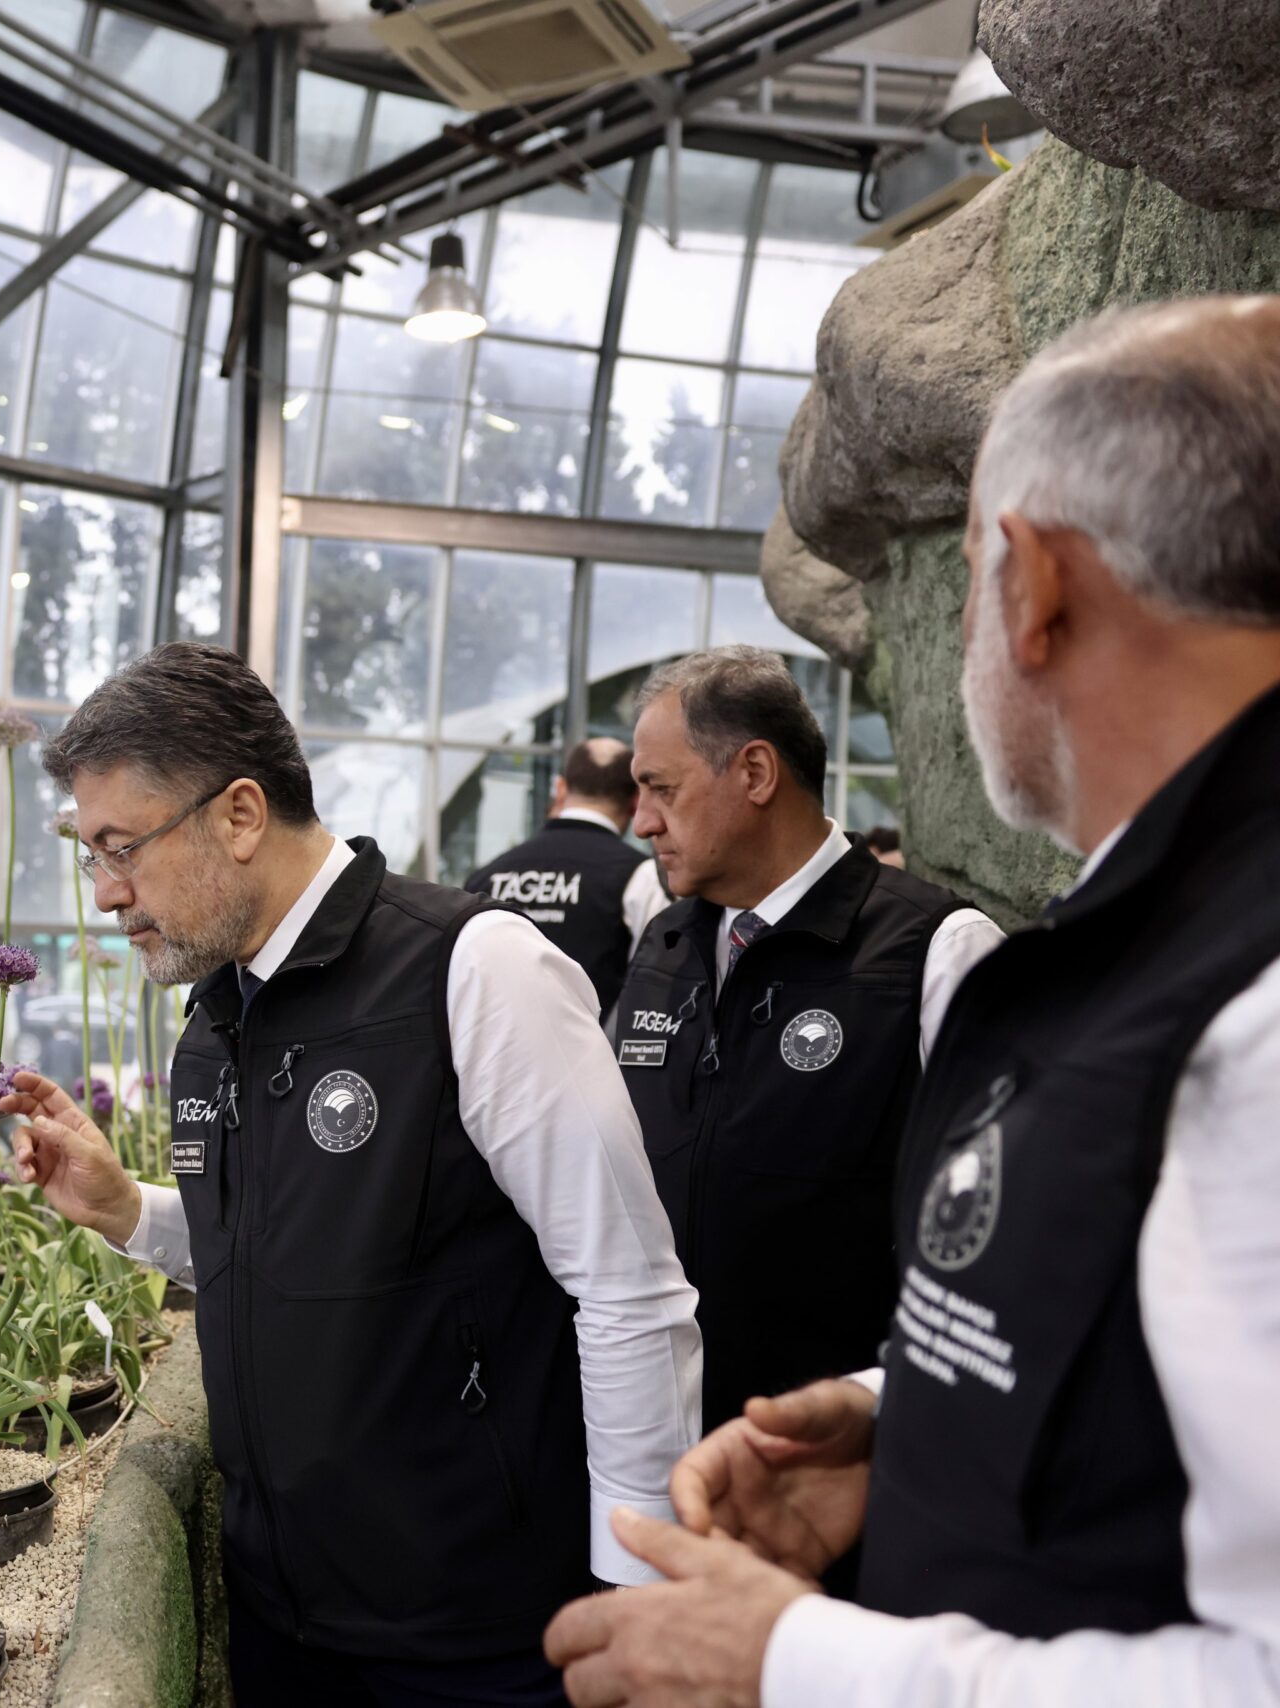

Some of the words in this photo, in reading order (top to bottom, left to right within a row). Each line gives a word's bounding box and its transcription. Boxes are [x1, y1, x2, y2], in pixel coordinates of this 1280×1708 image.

[489, 870, 581, 904] TAGEM
[632, 1010, 683, 1036] TAGEM
[177, 1098, 218, 1123] TAGEM
